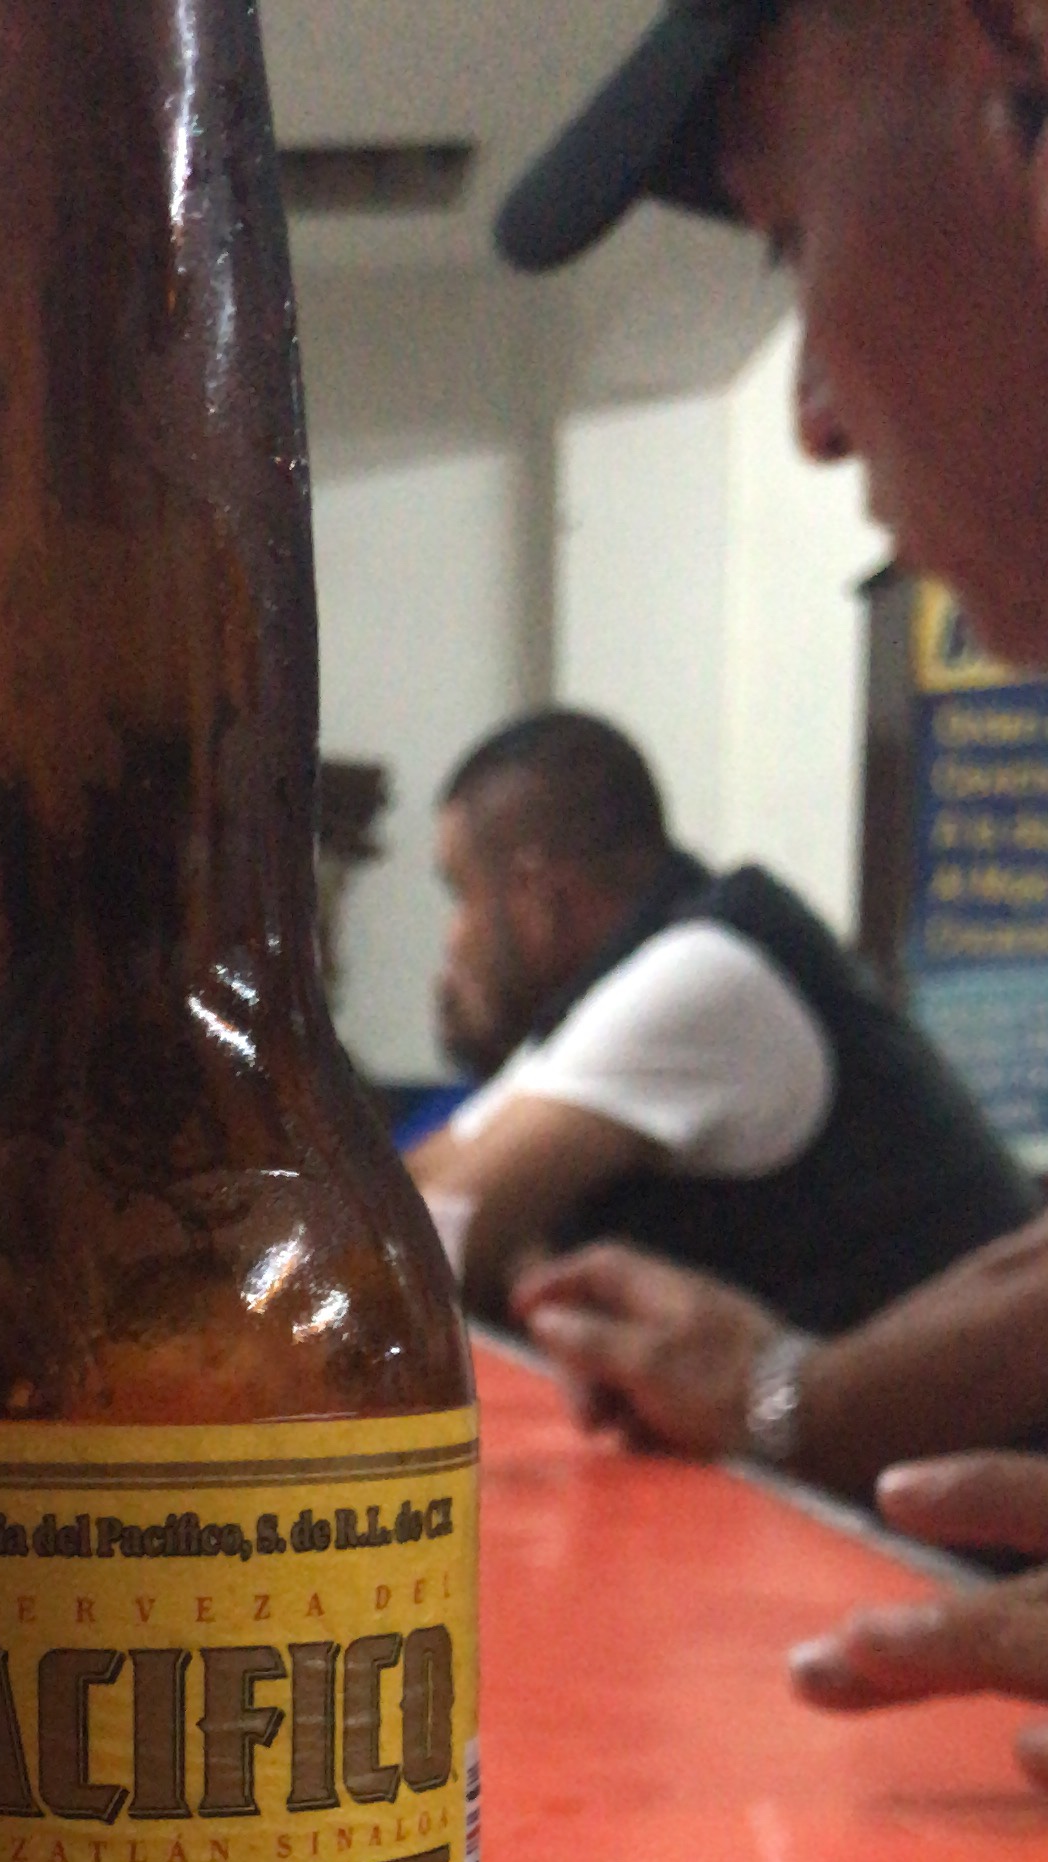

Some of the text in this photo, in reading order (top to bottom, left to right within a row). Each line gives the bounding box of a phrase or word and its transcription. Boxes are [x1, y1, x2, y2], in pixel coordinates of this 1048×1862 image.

[32, 1512, 93, 1557] del
[256, 1513, 287, 1555] S.
[290, 1509, 331, 1553] de
